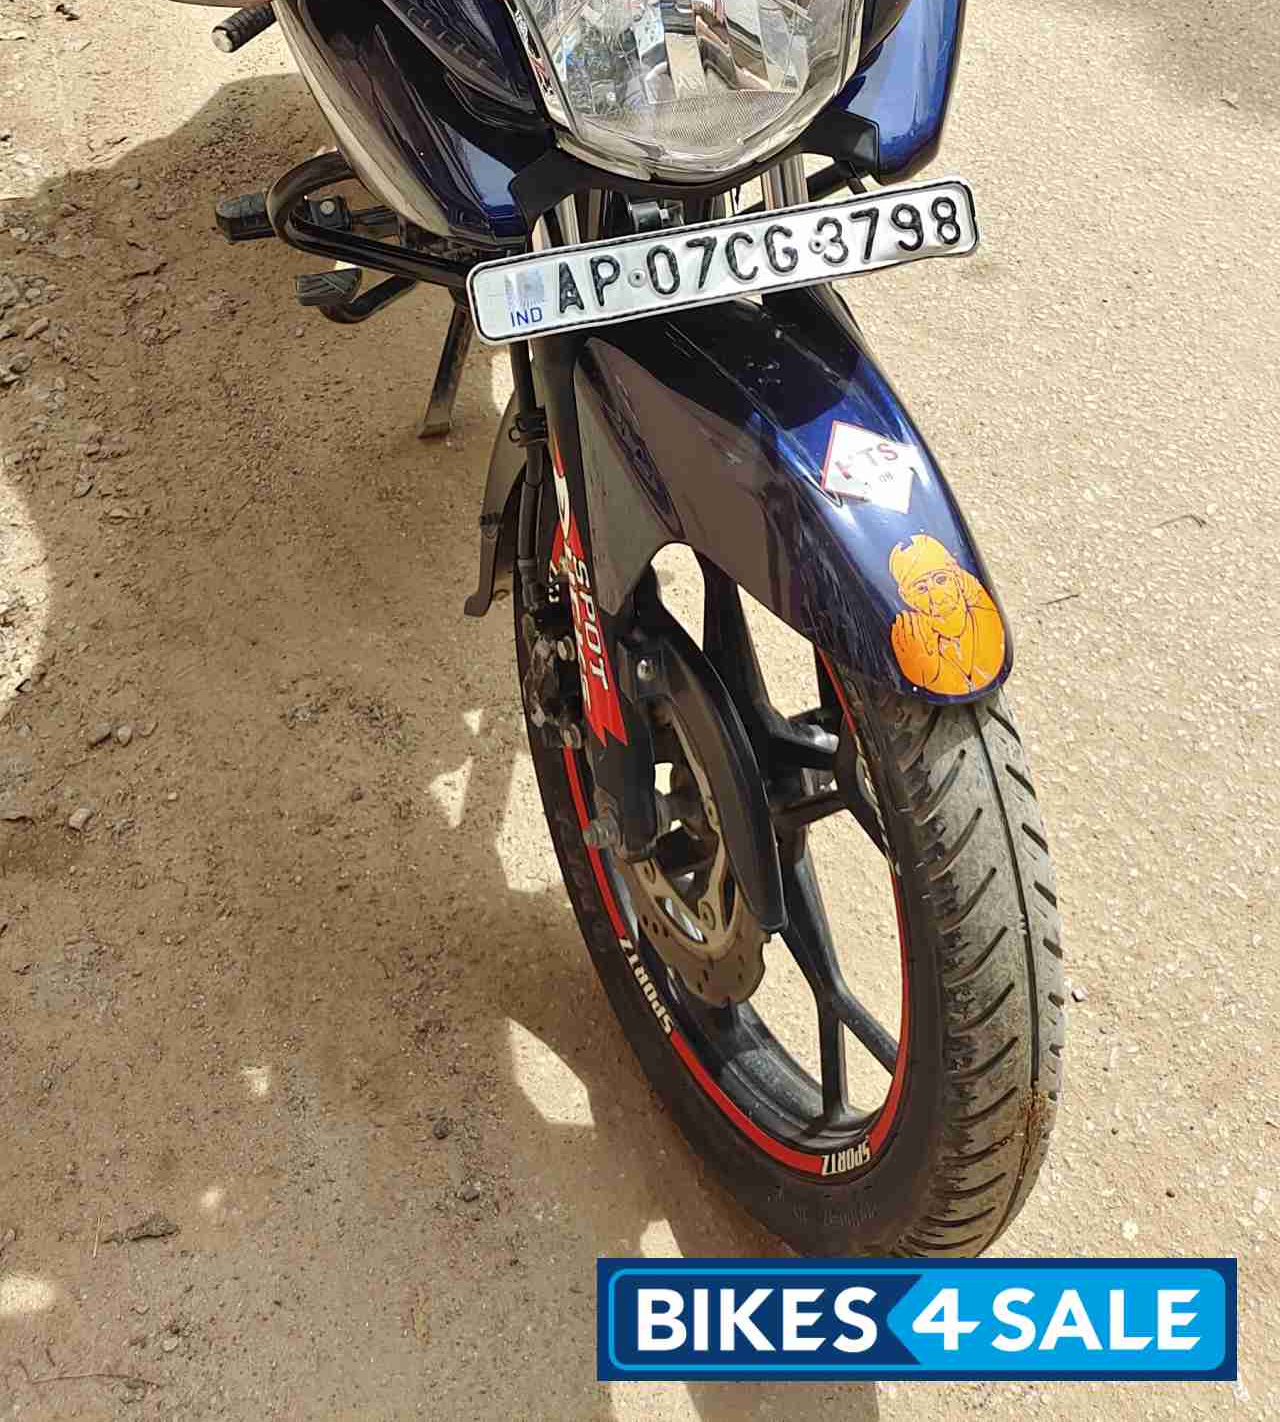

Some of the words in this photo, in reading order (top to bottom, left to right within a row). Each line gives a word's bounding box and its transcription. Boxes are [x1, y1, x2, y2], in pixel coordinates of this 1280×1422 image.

[510, 307, 543, 328] IND
[619, 938, 673, 1034] SPORTZ
[821, 1134, 871, 1176] SPORTZ
